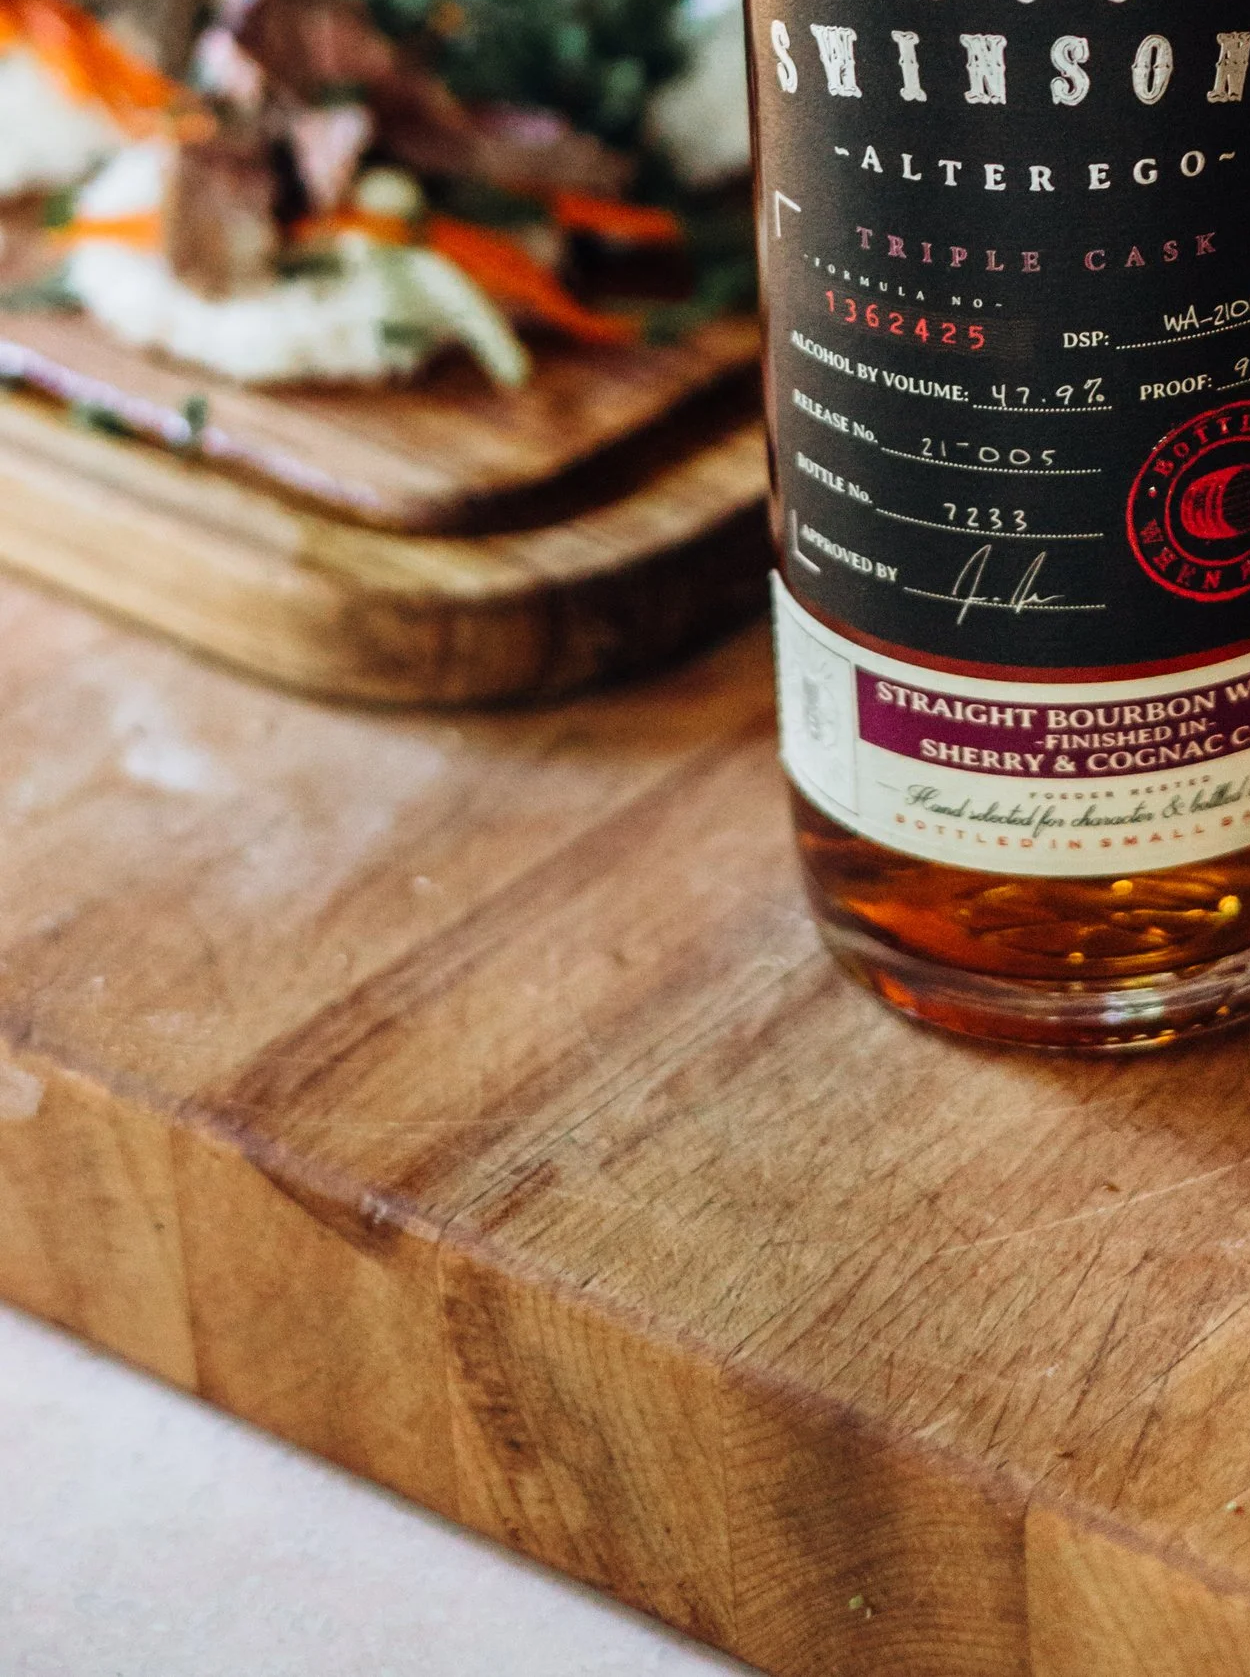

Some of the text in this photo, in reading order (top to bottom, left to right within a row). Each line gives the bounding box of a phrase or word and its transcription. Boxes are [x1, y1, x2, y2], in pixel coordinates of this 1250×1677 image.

[856, 226, 1217, 273] TRIPLE CASK
[825, 289, 986, 351] 1362425
[1062, 331, 1110, 349] DSP:
[790, 329, 854, 375] ALCOHOL
[856, 362, 883, 384] BY
[882, 369, 970, 403] VOLUME:
[1139, 374, 1213, 401] PROOF:
[792, 388, 1057, 466] RELEASE No. 21-005
[796, 450, 1028, 532] BOTTLE No. 7233
[800, 523, 899, 583] APPROVED BY
[1140, 518, 1224, 591] WHEN
[875, 679, 1038, 728] STRAIGHT
[1046, 689, 1218, 730] BOURBON
[919, 738, 1046, 772] SHERRY
[1052, 754, 1077, 773] &
[1085, 733, 1225, 771] COGNAC
[894, 812, 1034, 849] BOTTLED
[1051, 839, 1083, 850] IN
[1099, 825, 1205, 849] SMALL
[905, 784, 971, 819] Hand
[1031, 804, 1069, 839] for
